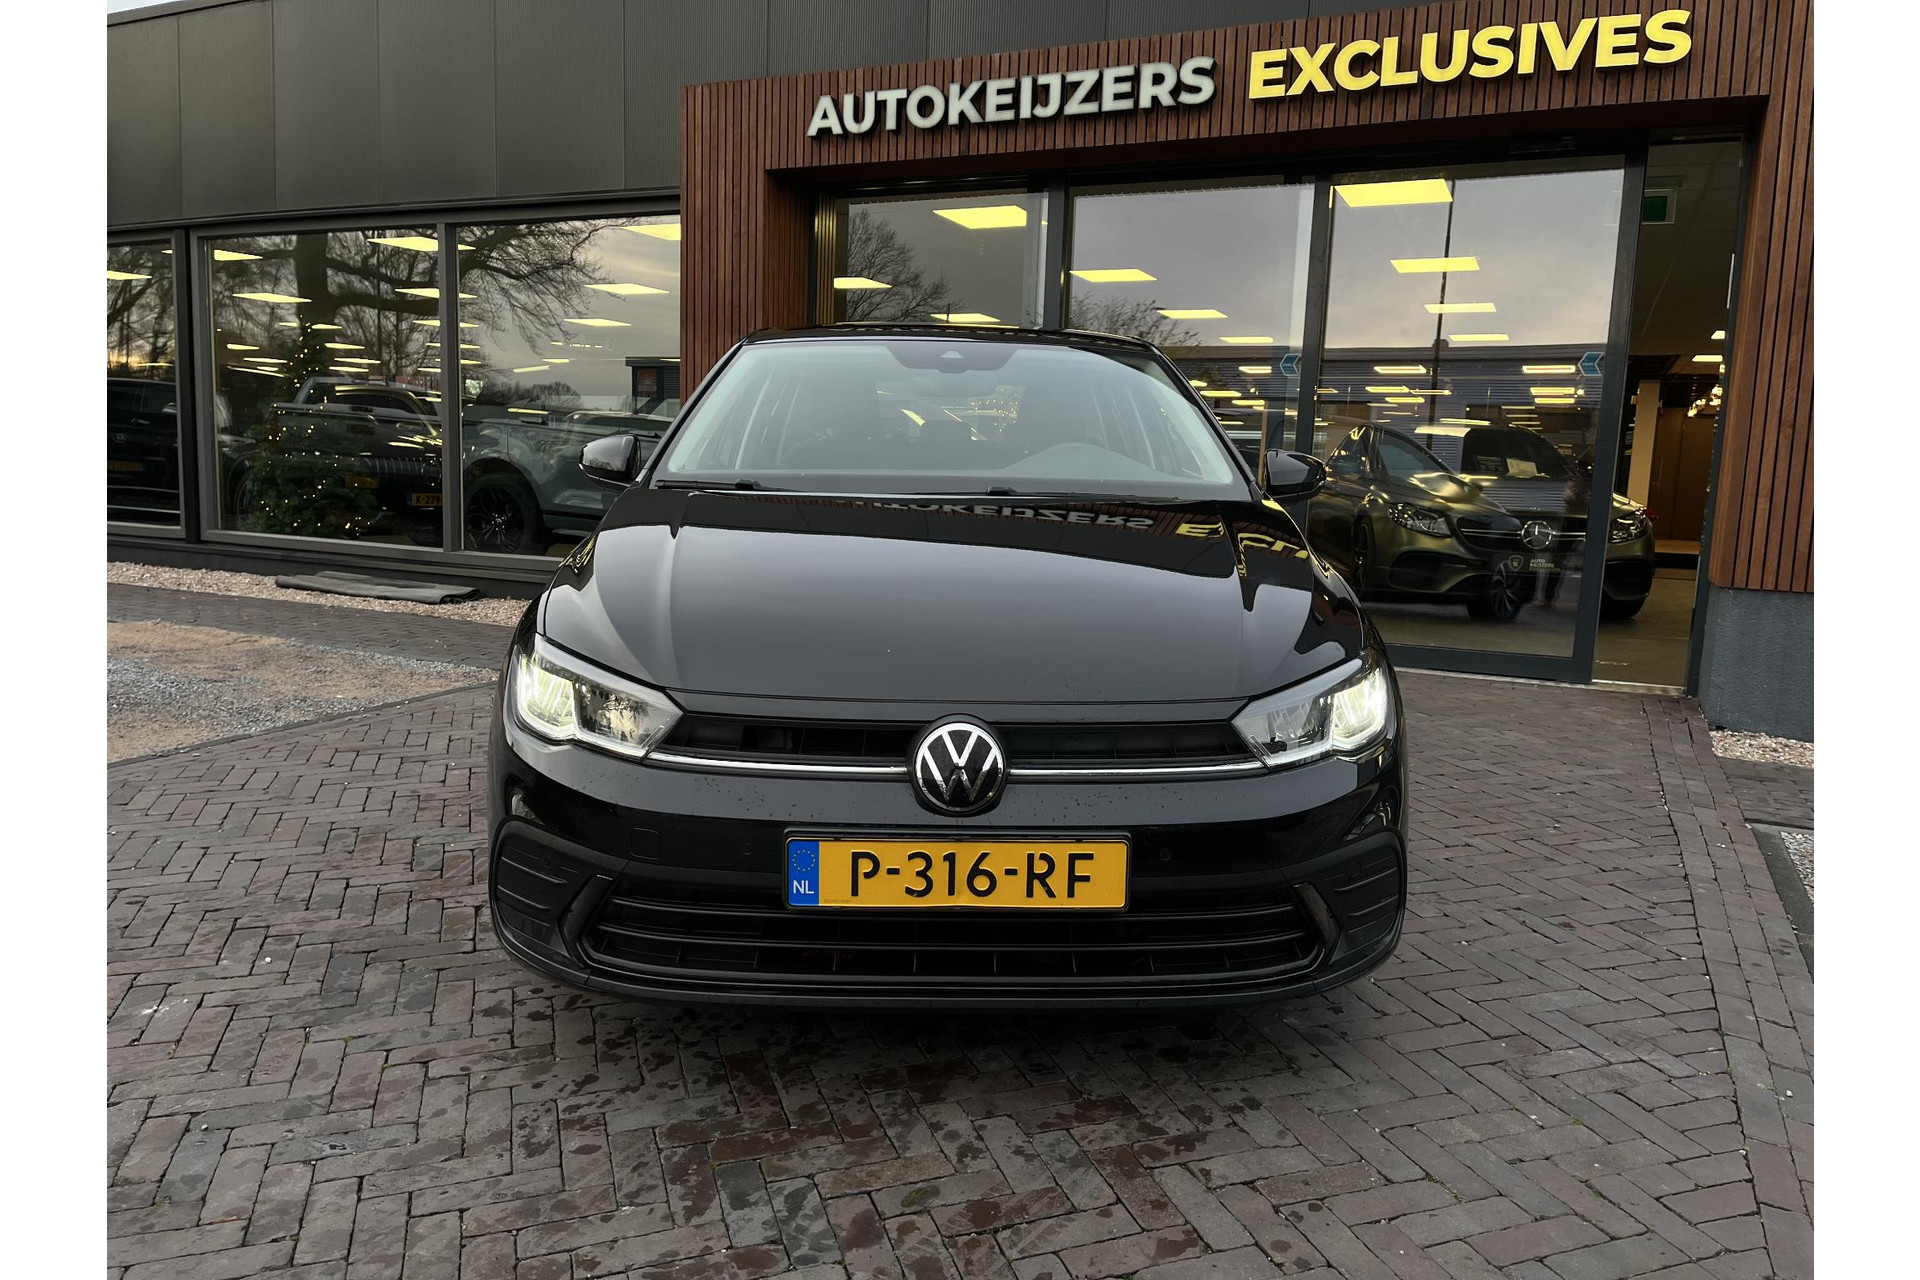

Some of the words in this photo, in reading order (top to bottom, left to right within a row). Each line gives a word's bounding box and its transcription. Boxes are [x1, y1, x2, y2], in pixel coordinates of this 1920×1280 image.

[806, 56, 1215, 138] AUTOKEIJZERS
[1248, 9, 1692, 99] EXCLUSIVES
[793, 880, 814, 894] NL
[851, 851, 1094, 898] P-316-RF
